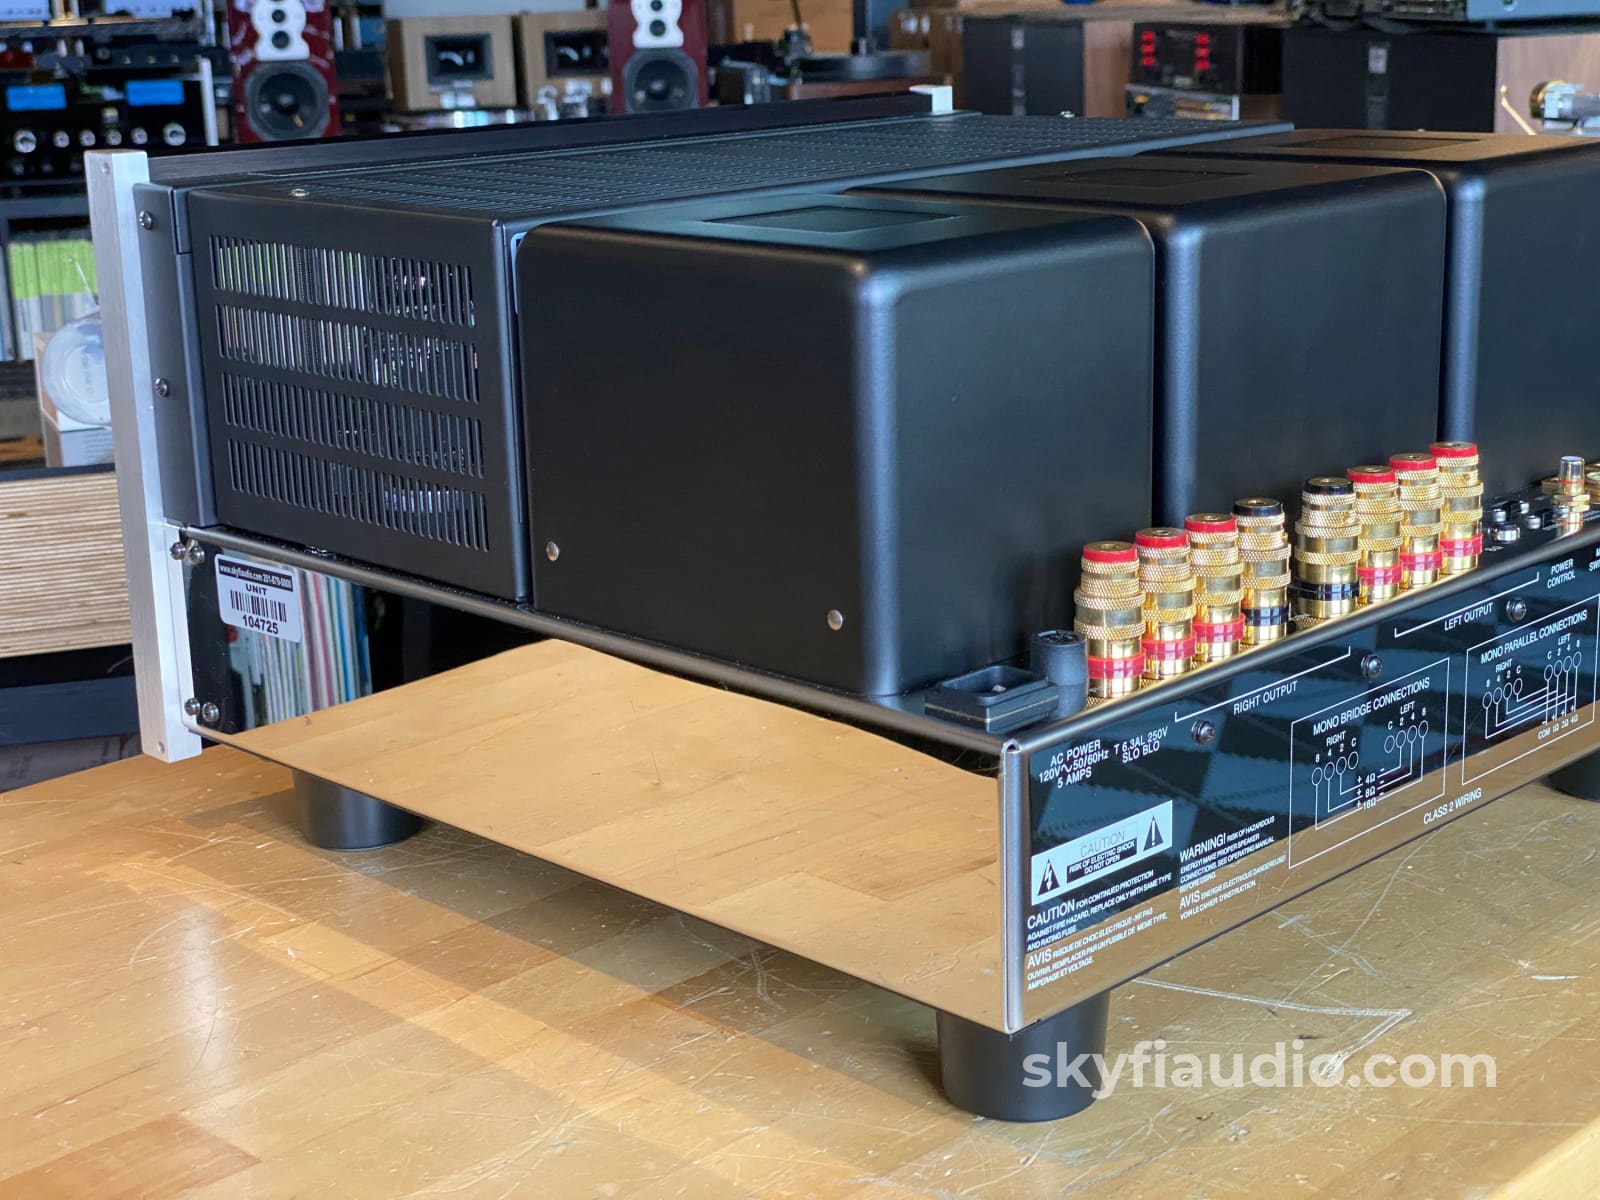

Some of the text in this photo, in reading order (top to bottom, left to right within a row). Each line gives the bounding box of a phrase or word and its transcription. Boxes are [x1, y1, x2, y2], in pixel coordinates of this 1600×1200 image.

[1551, 558, 1574, 575] POWER
[246, 584, 267, 595] UNIT
[1547, 570, 1575, 588] CONTROL
[242, 614, 278, 634] 104725
[1444, 602, 1493, 631] LEFT OUTPUT
[1481, 609, 1588, 664] MONO PARALLEL CONNECTIONS
[1558, 633, 1571, 645] LEFT
[1496, 659, 1512, 673] RIGHT
[1233, 680, 1298, 715] RIGHT OUTPUT
[1313, 677, 1430, 736] MONO BRIDGE CONNECTIONS
[1400, 701, 1415, 715] LEFT
[1388, 721, 1393, 730] C
[1411, 712, 1415, 720] 4
[1114, 726, 1168, 755] T 6.3AL 250V
[1326, 730, 1346, 747] RIGHT
[1328, 748, 1332, 757] 4
[1351, 738, 1357, 747] C
[1050, 740, 1100, 766] AC POWER
[1122, 741, 1160, 763] SLO BLO
[1058, 766, 1092, 788] 5 AMPS
[1424, 787, 1482, 824] CLASS 2 WIRING
[1080, 831, 1125, 858] CAUTION
[1180, 833, 1226, 862] WARNING!
[1227, 832, 1238, 841] RISK
[1246, 816, 1275, 833] HAZARDOUS
[1217, 843, 1237, 857] PROPER
[1238, 833, 1260, 847] SPEAKER
[1082, 860, 1090, 868] OF
[1091, 850, 1116, 864] ELECTRIC
[1116, 840, 1135, 854] SHOCK
[1084, 854, 1120, 874] DO NOT OPEN
[1027, 925, 1052, 942] AGAINST
[1053, 920, 1065, 931] FIRE
[1091, 898, 1115, 914] REPLACE
[1116, 891, 1130, 903] ONLY
[1130, 885, 1144, 897] WITH
[1144, 879, 1158, 891] SAME
[1158, 873, 1172, 884] TYPE
[1028, 870, 1154, 930] CAUTION FOR CONTINUED PROTECTION
[1180, 890, 1200, 908] AVIS
[1027, 941, 1041, 952] AND
[1028, 948, 1052, 969] AVIS
